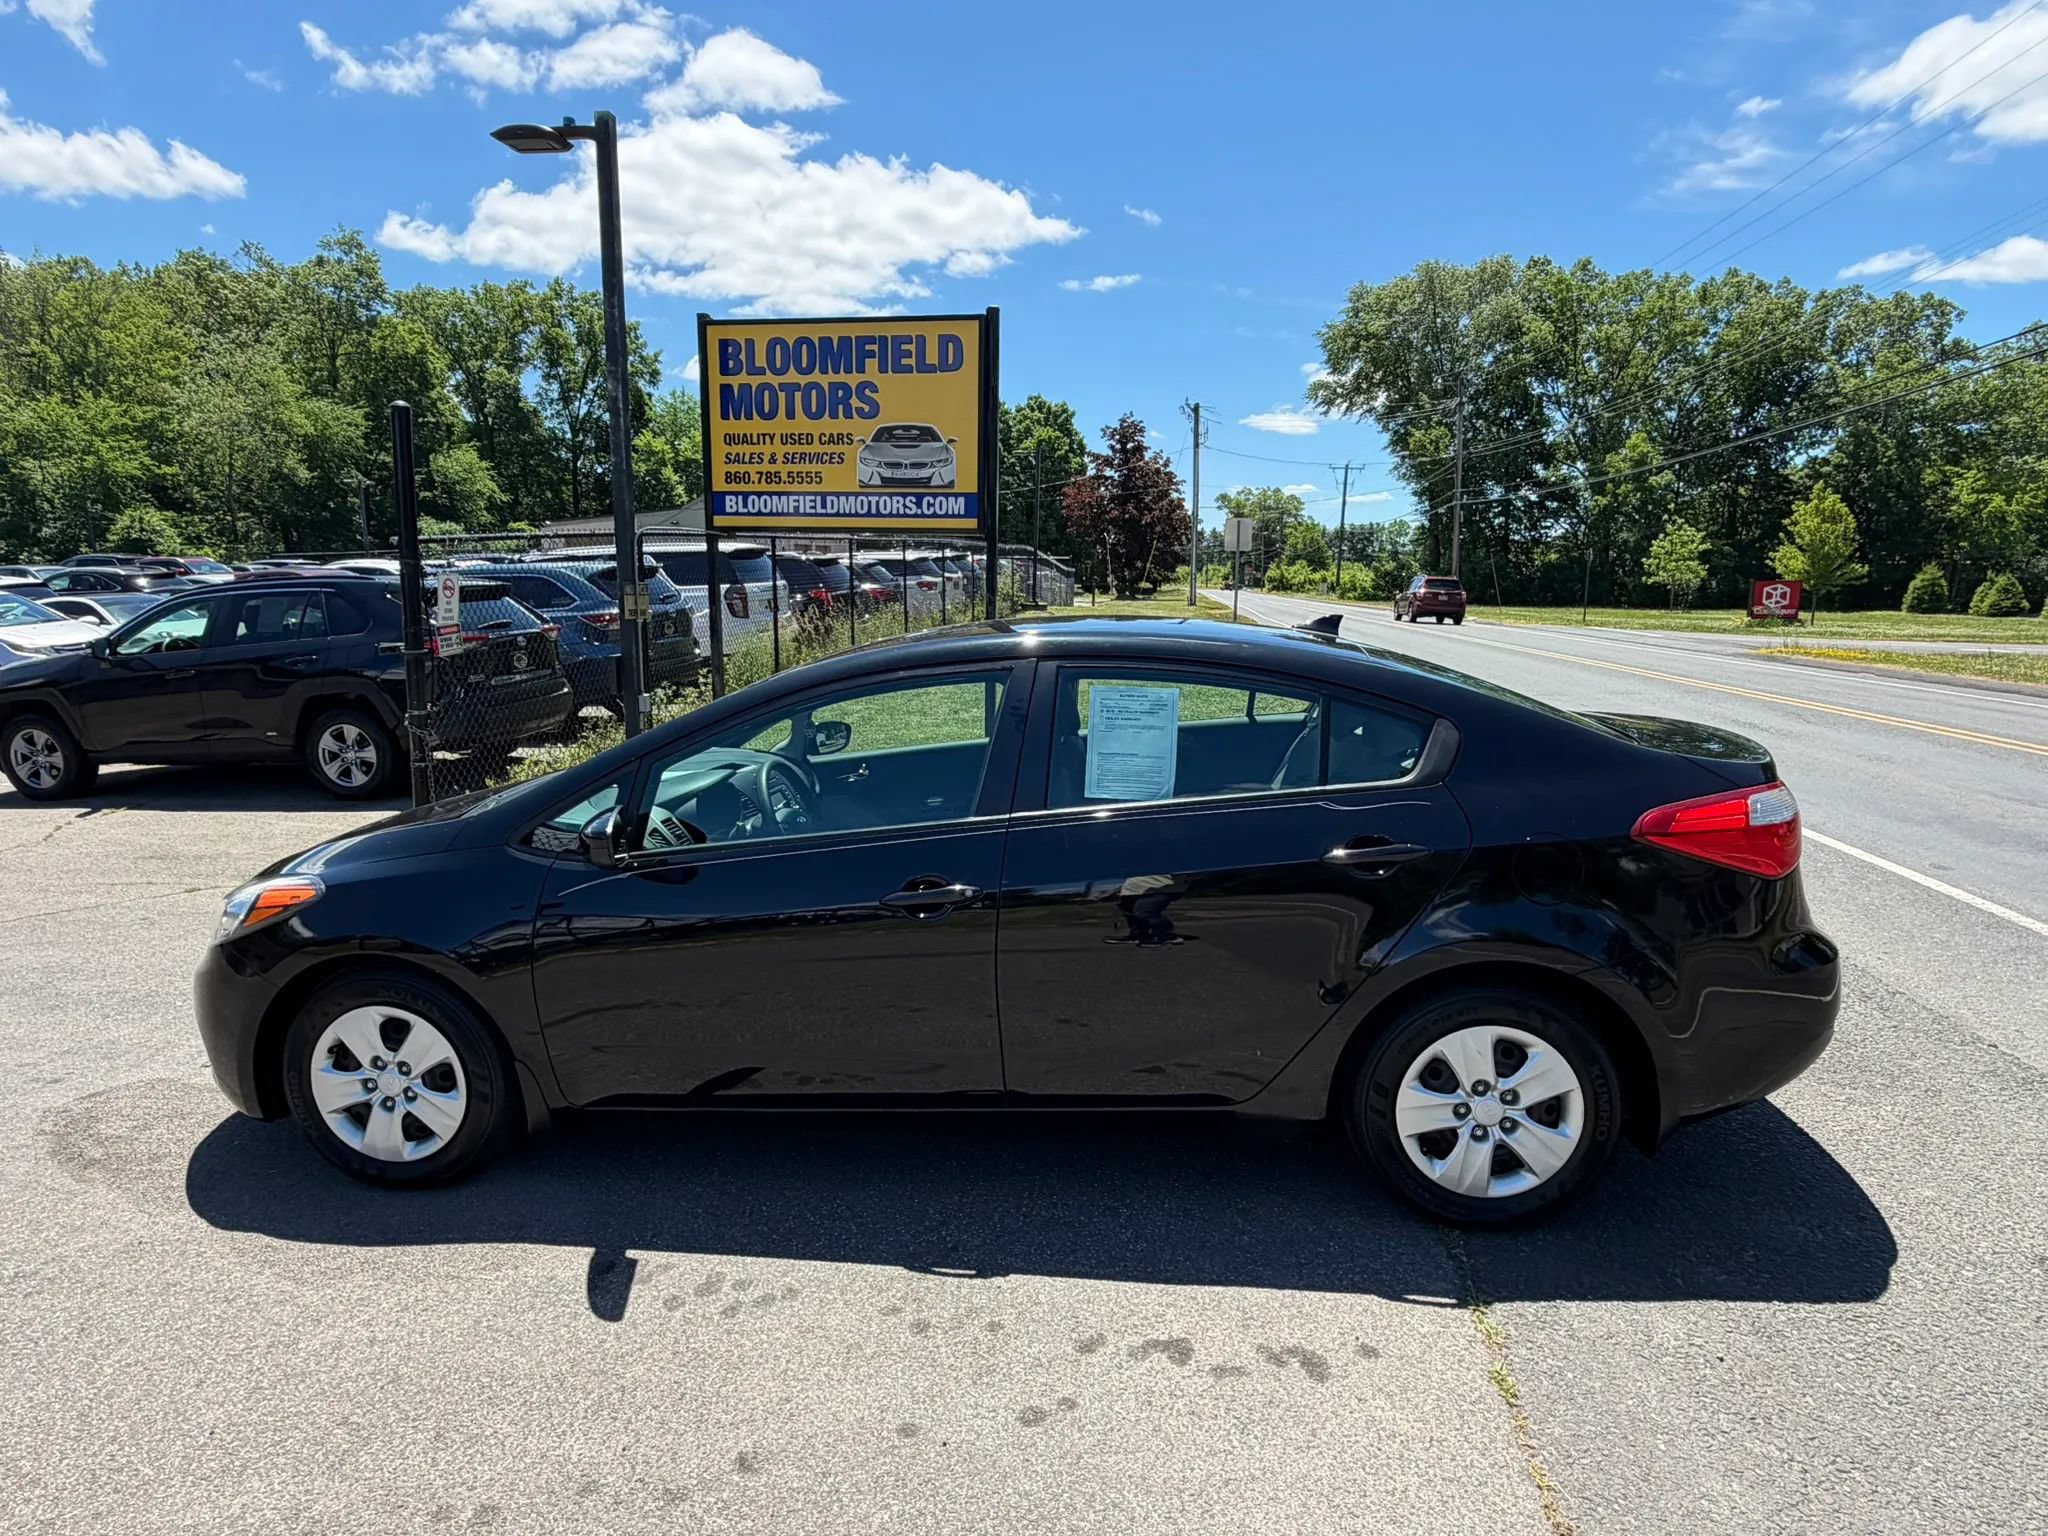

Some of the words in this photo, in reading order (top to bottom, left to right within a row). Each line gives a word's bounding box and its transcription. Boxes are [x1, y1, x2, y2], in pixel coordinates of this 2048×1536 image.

[718, 333, 964, 376] BLOOMFIELD
[719, 380, 881, 421] MOTORS
[723, 432, 777, 447] QUALITY
[780, 432, 815, 446] USED
[818, 432, 854, 446] CARS
[723, 451, 765, 465] SALES
[768, 452, 778, 465] &
[782, 451, 846, 465] SERVICES
[724, 470, 823, 485] 860.785.5555
[725, 494, 965, 516] BLOOMFIELDMOTORS.COM
[1589, 1064, 1611, 1141] KUMHO
